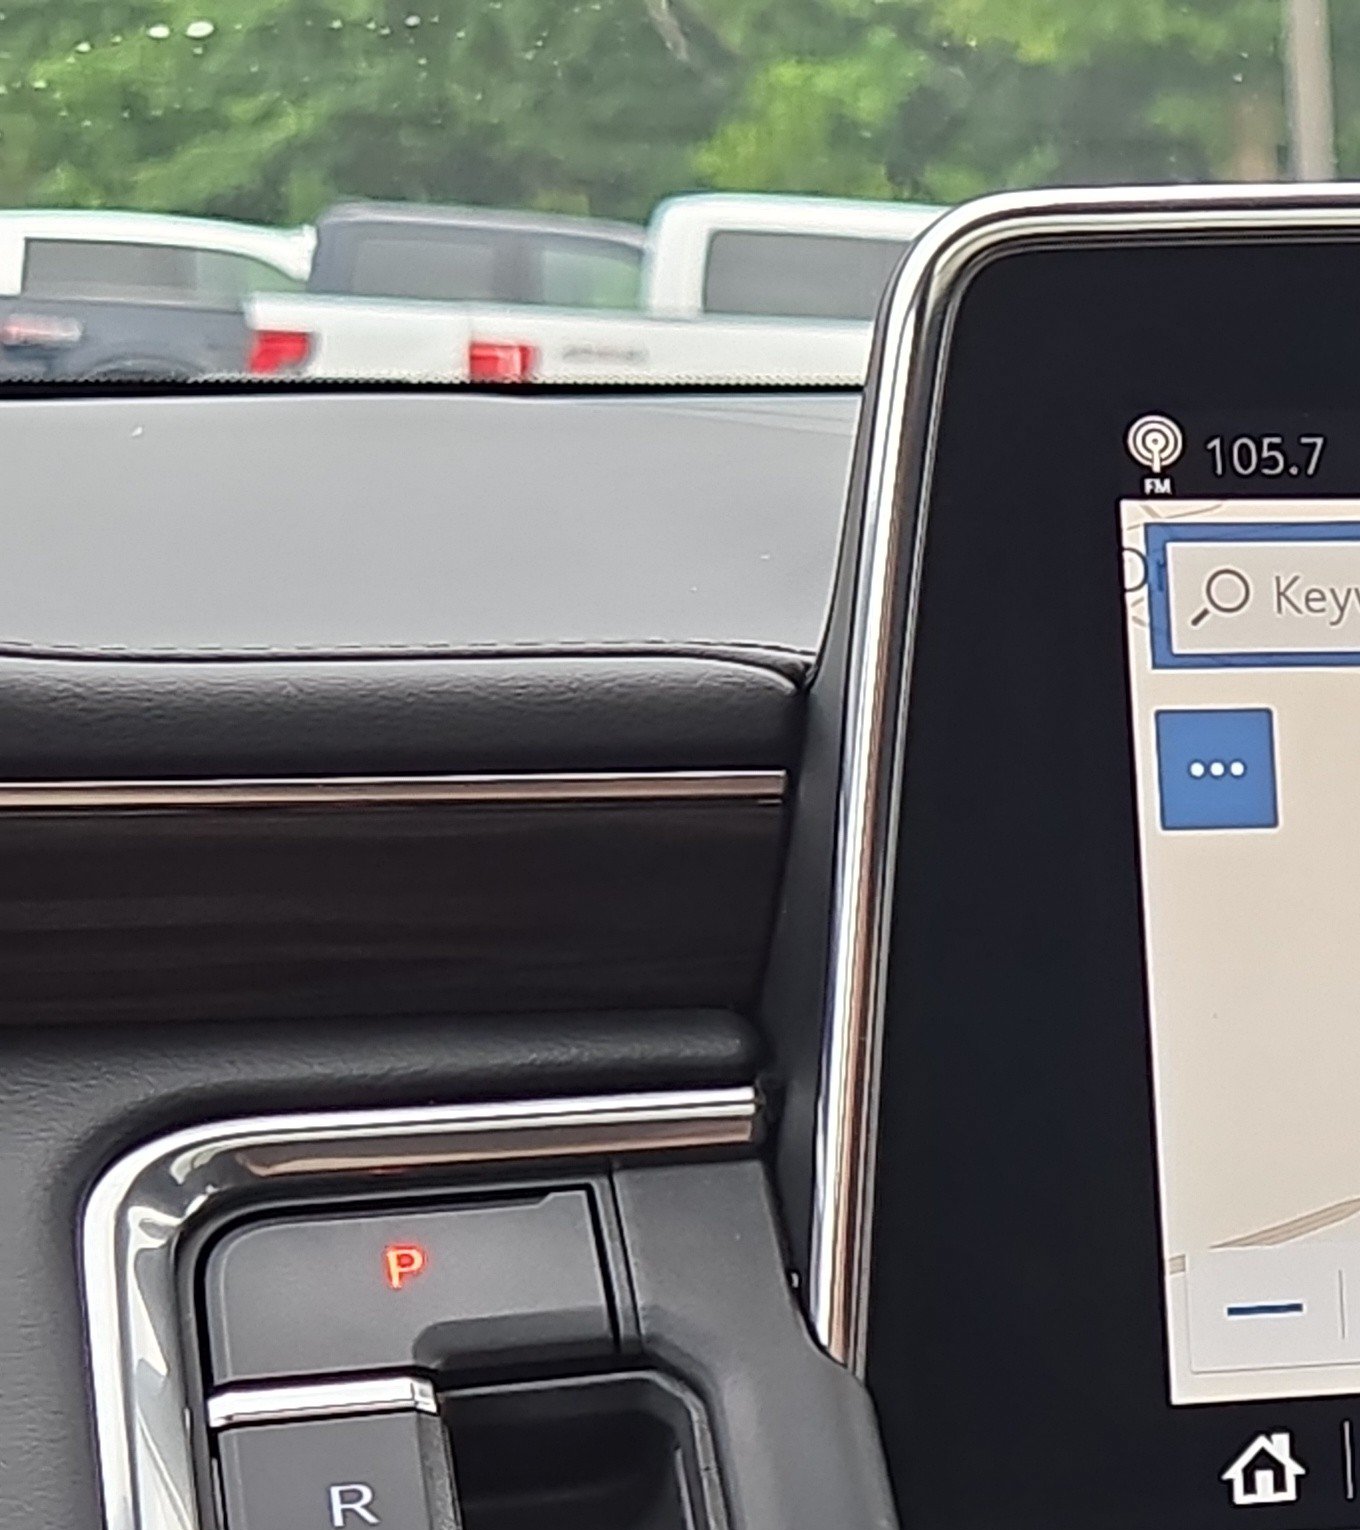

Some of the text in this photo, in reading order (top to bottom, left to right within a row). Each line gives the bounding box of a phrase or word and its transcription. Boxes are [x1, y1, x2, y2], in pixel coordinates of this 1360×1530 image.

[1205, 436, 1326, 477] 105.7
[1144, 478, 1172, 494] FM
[386, 1245, 424, 1289] P
[329, 1484, 379, 1527] R
